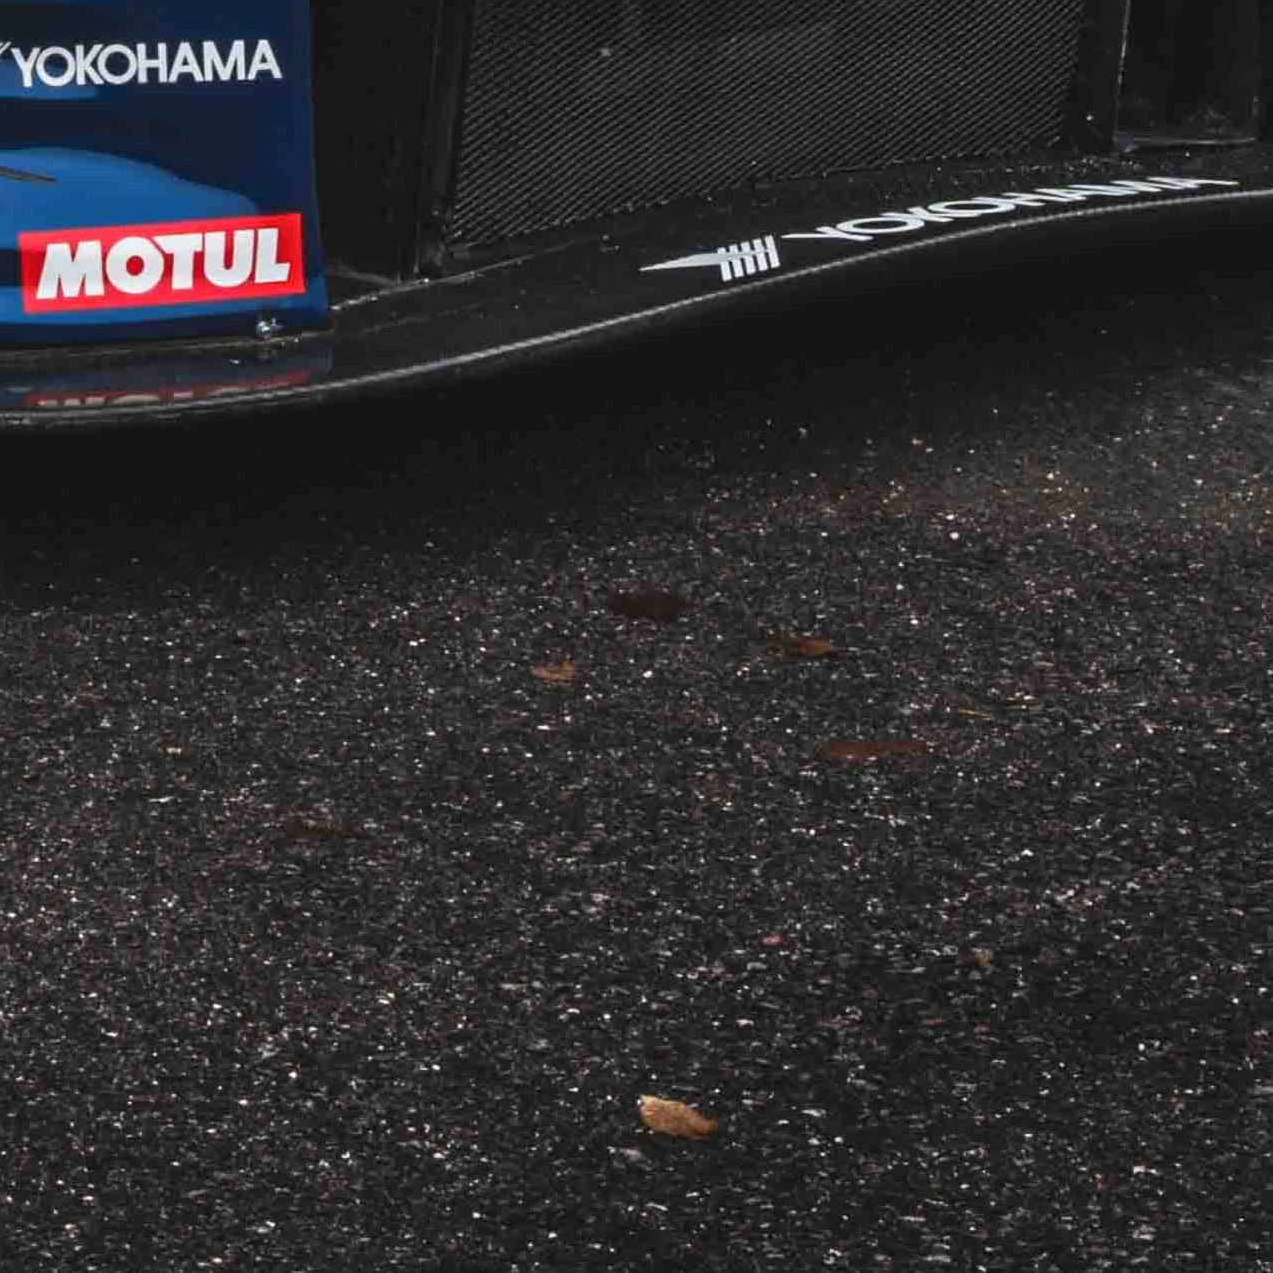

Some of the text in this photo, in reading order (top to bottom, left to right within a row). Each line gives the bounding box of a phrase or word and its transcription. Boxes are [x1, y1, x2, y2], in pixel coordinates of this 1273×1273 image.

[11, 39, 283, 89] YOKOHAMA
[781, 175, 1239, 242] YOKOHAMA
[35, 227, 292, 300] MOTUL
